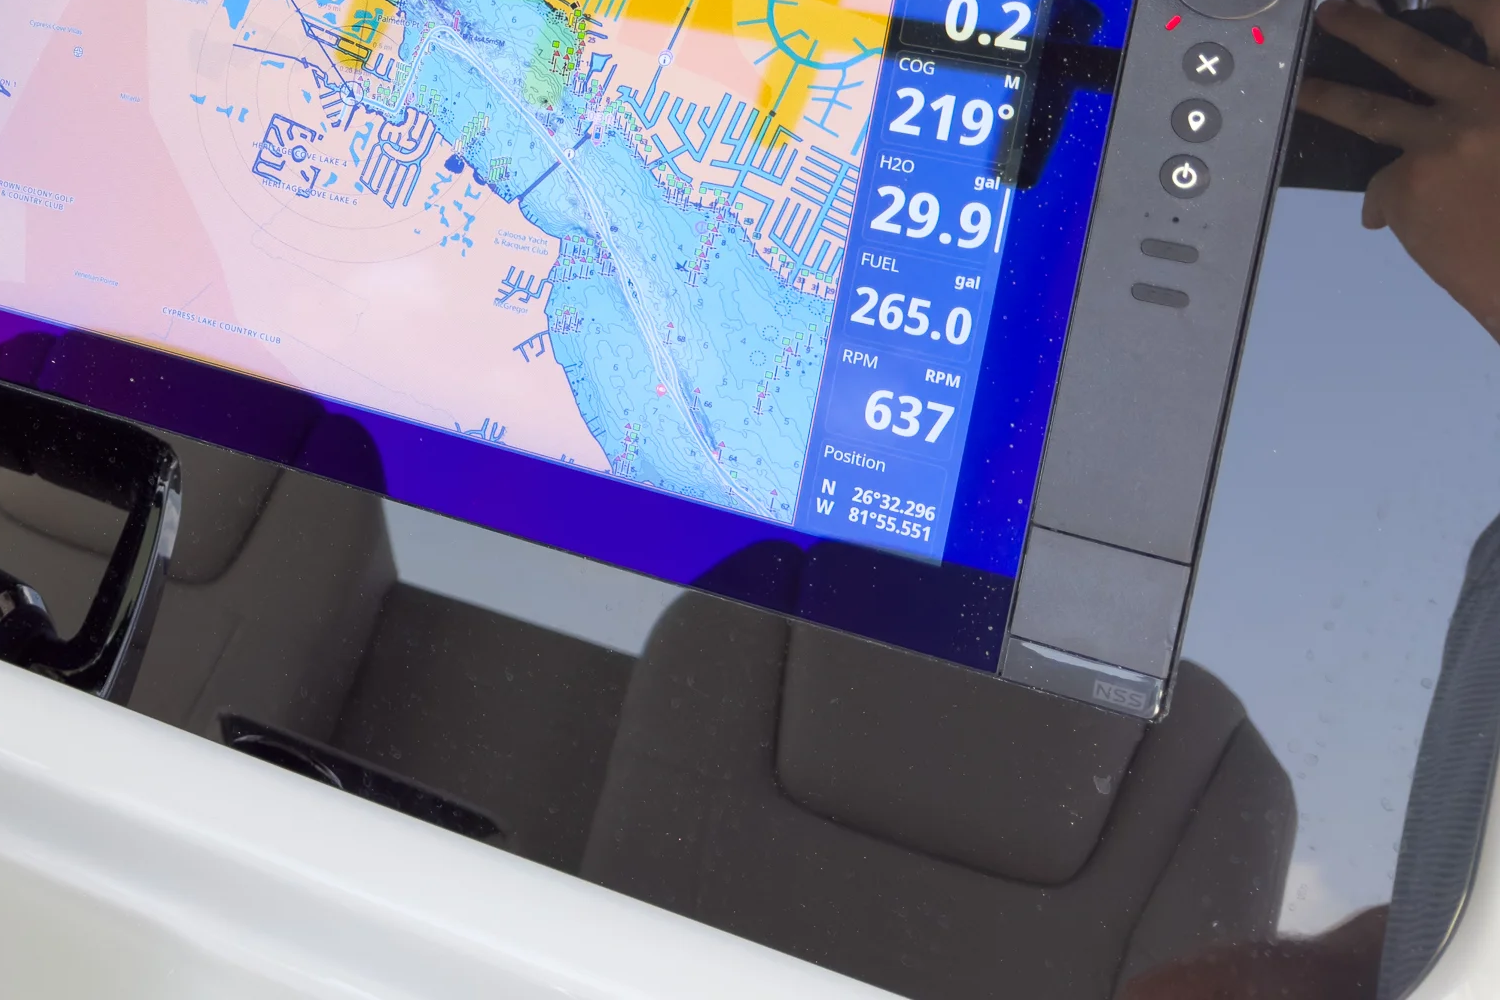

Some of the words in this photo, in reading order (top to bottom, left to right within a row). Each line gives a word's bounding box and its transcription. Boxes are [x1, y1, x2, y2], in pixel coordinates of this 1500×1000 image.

[377, 15, 410, 27] Palmetto
[899, 57, 935, 76] COG
[1004, 75, 1020, 90] M
[889, 87, 1015, 147] 219°
[252, 142, 291, 155] HERITAGE
[294, 150, 317, 161] COVE
[320, 155, 340, 166] LAKE
[880, 155, 915, 174] H2O
[262, 179, 301, 193] HERITAGE
[330, 194, 351, 204] LAKE
[974, 175, 1000, 192] gal
[8, 191, 42, 204] COUNTRY
[44, 200, 64, 210] CLUB
[23, 186, 52, 198] COLONY
[55, 193, 74, 203] GOLF
[869, 184, 992, 249] 29.9
[498, 229, 526, 242] Caloosa
[528, 236, 548, 246] Yacht
[501, 239, 530, 253] Racquet
[532, 246, 548, 255] Club
[861, 252, 899, 273] FUEL
[954, 274, 981, 291] gal
[493, 301, 528, 314] McGregor
[850, 286, 973, 345] 265.0
[162, 307, 195, 321] CYPRESS
[198, 315, 217, 327] LAKE
[219, 322, 257, 337] COUNTRY
[260, 332, 281, 344] CLUB
[842, 349, 878, 370] RPM
[924, 369, 961, 389] RPM
[864, 389, 955, 444] 637
[824, 445, 886, 473] Position
[821, 479, 836, 496] N
[851, 487, 936, 522] 26°32.296
[816, 498, 835, 516] W
[848, 507, 931, 542] 81°55.551
[1096, 684, 1145, 708] NSS
